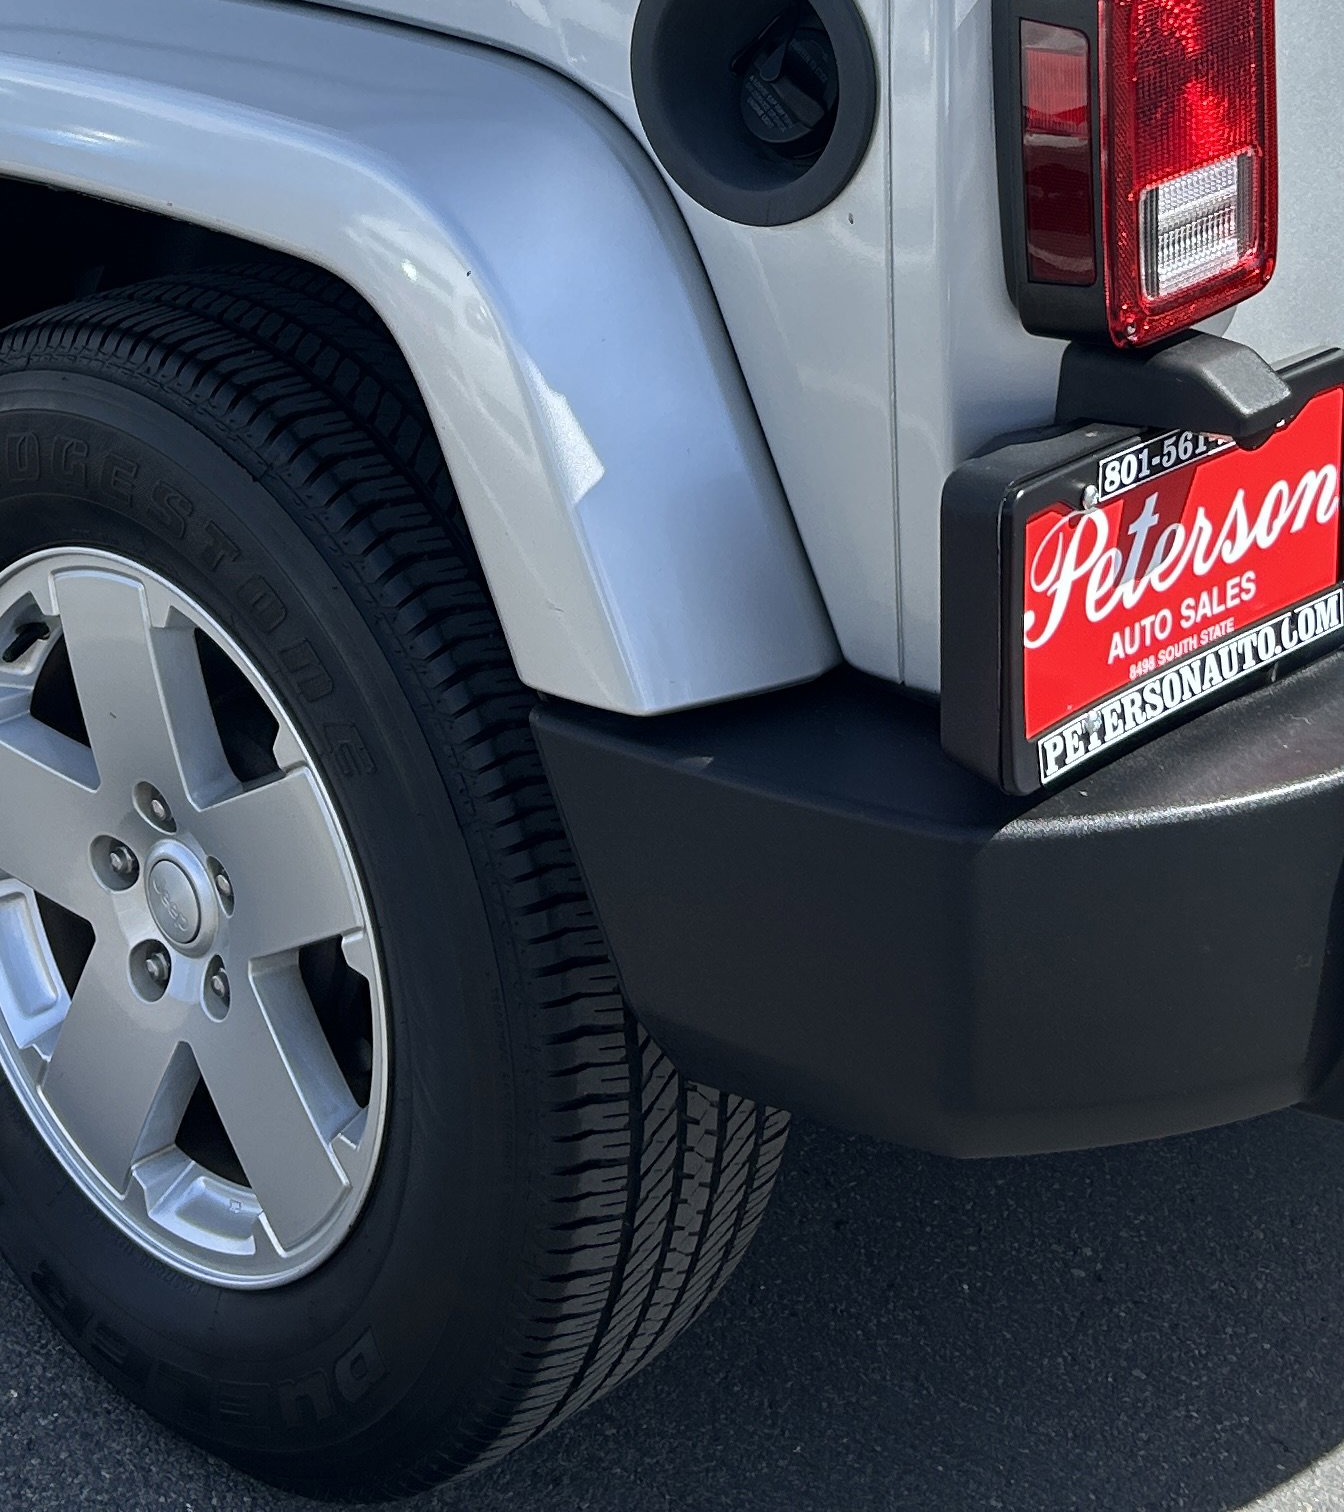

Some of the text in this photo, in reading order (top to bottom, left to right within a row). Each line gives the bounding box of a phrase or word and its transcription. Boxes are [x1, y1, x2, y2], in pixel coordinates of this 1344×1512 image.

[1024, 464, 1340, 649] Peterson
[1107, 571, 1256, 665] AUTO SALES
[1044, 594, 1340, 777] PETERSONAUTO.COM
[1157, 633, 1197, 666] SOUTH
[1199, 617, 1235, 645] STATE
